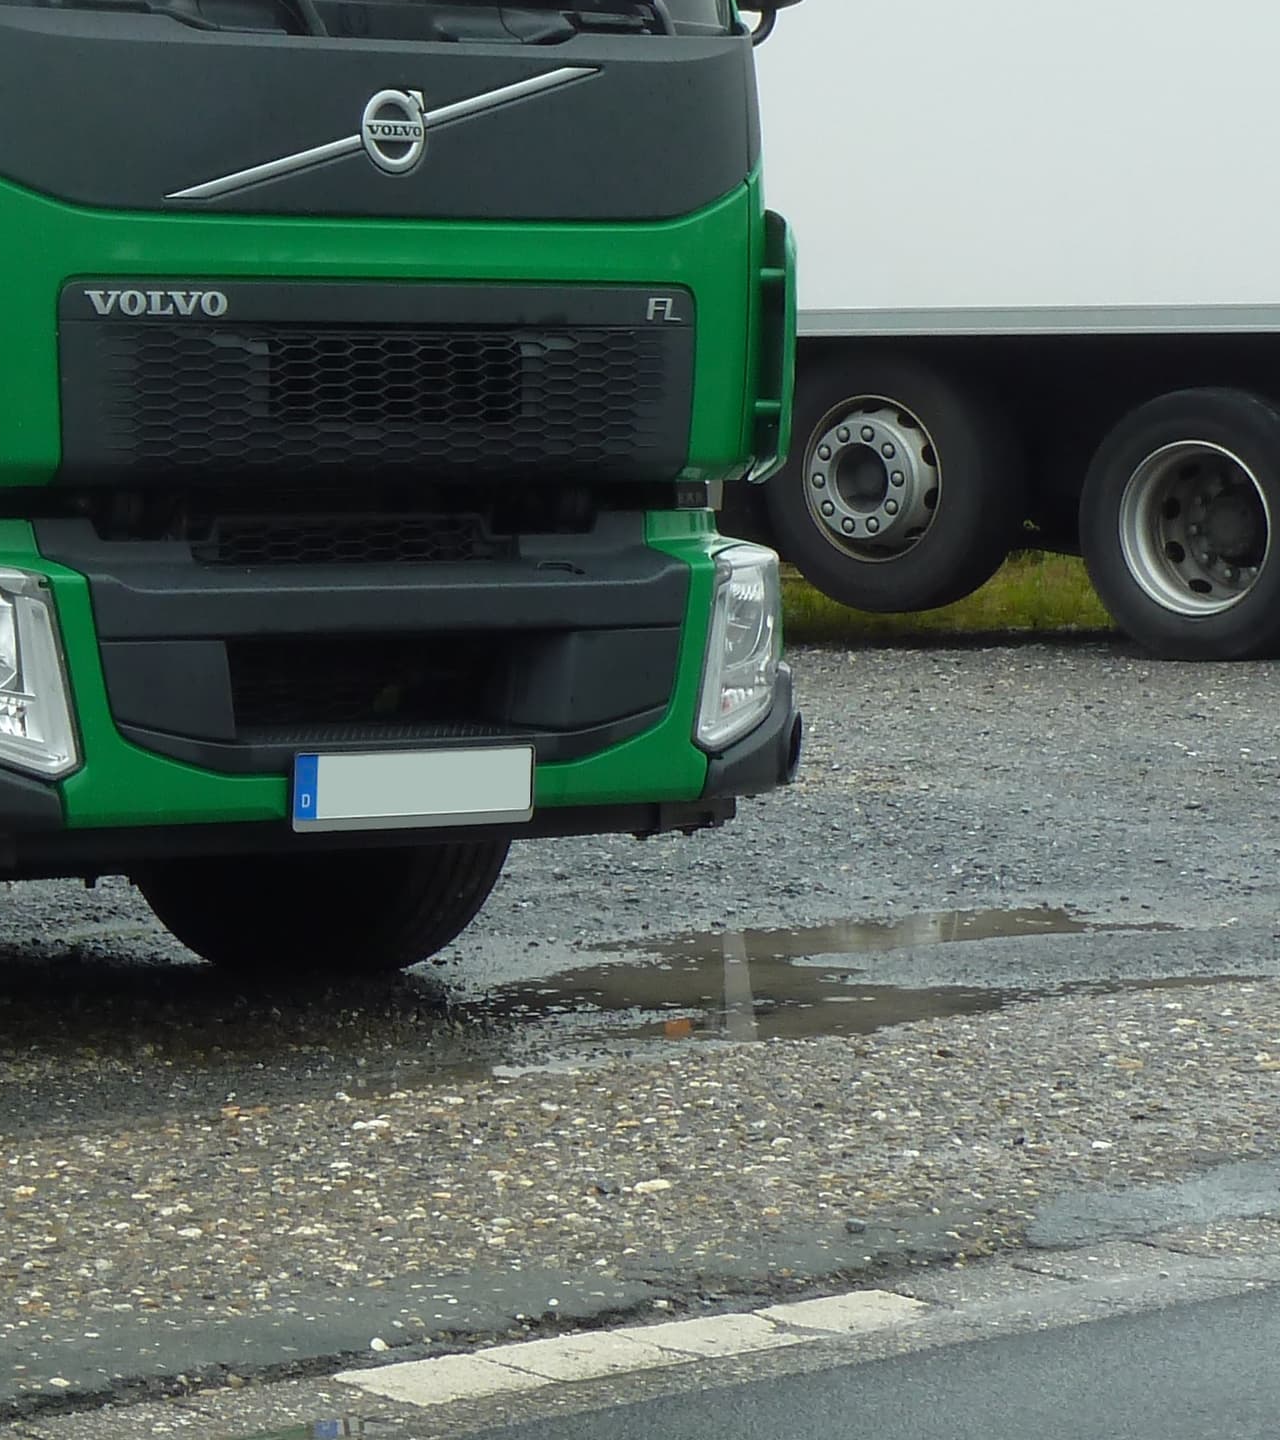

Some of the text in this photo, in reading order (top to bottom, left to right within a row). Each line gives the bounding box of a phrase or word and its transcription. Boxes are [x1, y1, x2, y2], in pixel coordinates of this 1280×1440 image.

[366, 125, 422, 137] VOLVO
[84, 290, 228, 316] VOLVO
[646, 298, 682, 320] FL
[301, 793, 311, 809] D
